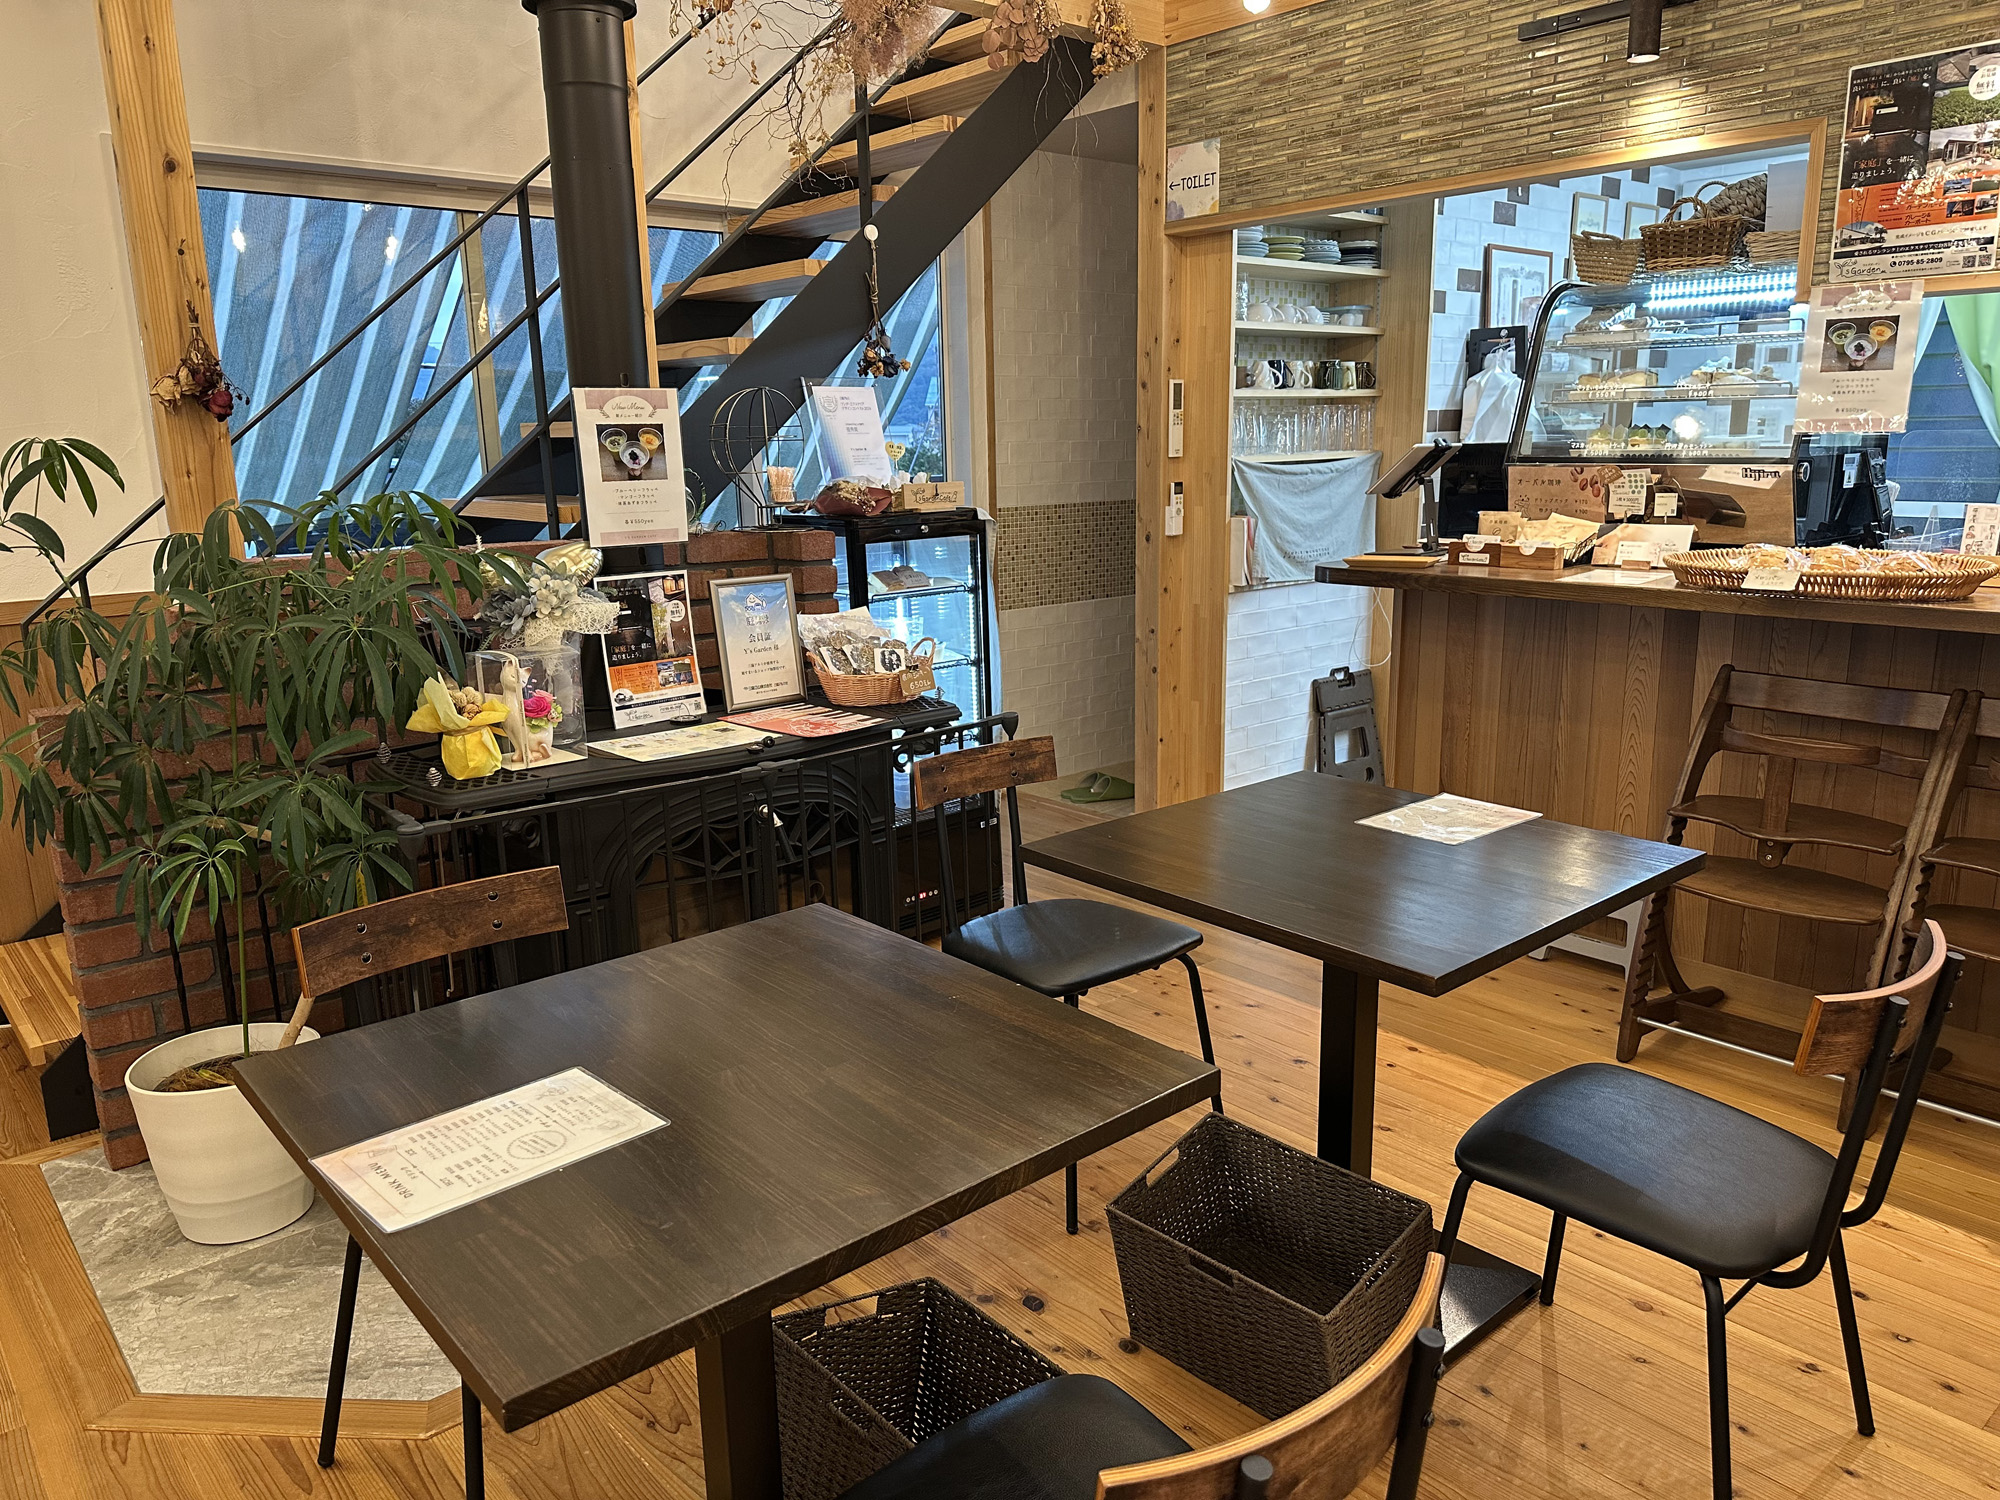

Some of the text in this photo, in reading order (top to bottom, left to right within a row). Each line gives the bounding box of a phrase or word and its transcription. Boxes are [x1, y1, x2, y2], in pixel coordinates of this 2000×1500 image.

[1181, 172, 1217, 190] TOILET
[1898, 257, 1943, 267] 0795-85-2809
[1741, 468, 1781, 481] Hijiru
[749, 632, 772, 643] 会員証
[366, 1161, 416, 1198] DRINK MENU
